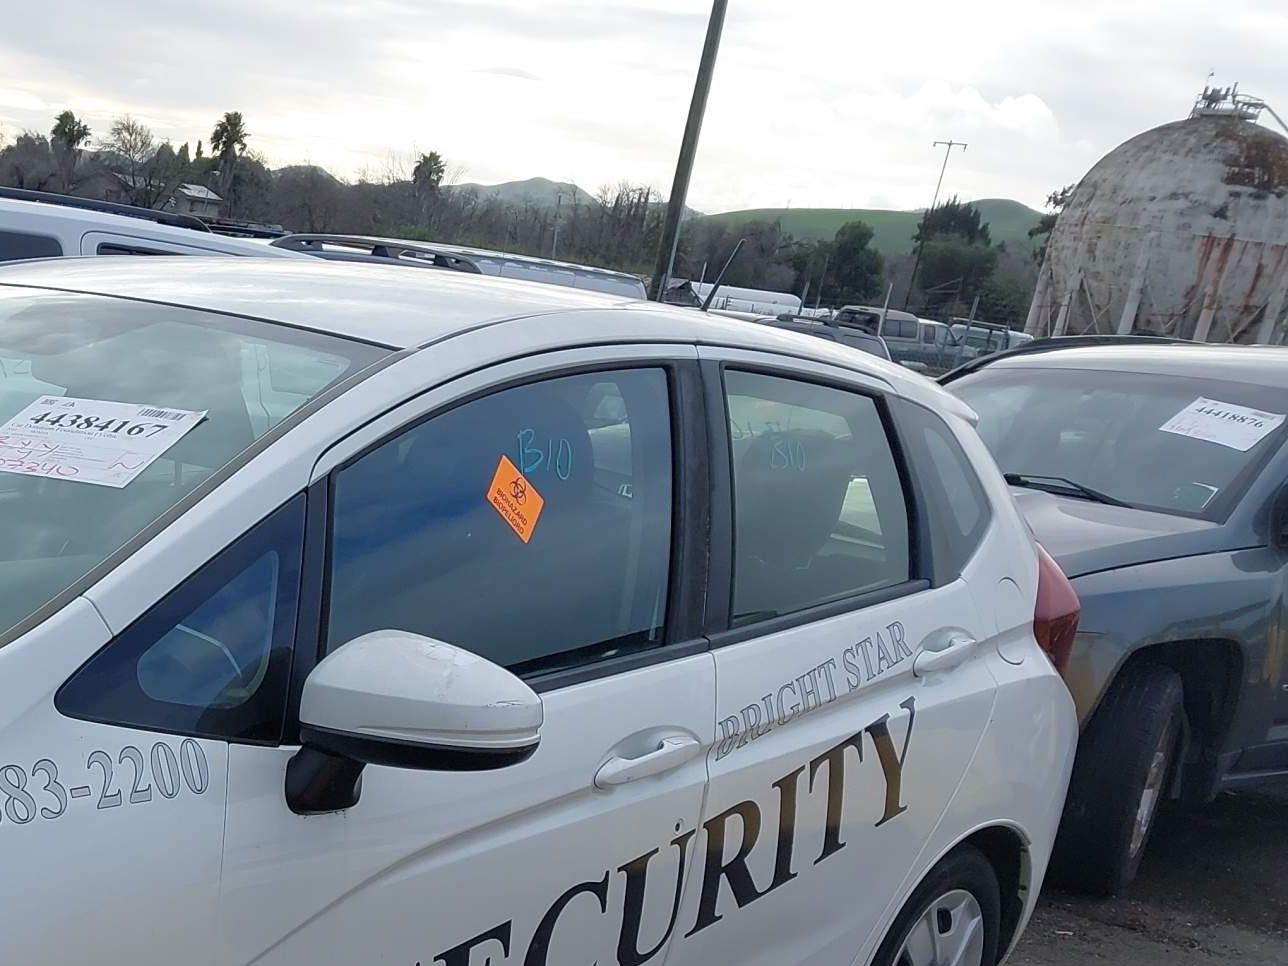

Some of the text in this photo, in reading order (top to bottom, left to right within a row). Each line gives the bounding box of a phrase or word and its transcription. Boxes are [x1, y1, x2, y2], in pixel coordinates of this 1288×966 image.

[30, 411, 168, 438] 44384167
[1195, 406, 1263, 429] 44418876
[492, 495, 525, 535] BIOPELIGRO
[496, 487, 528, 526] BIOHAZARD
[715, 620, 913, 762] BRIGHT STAR
